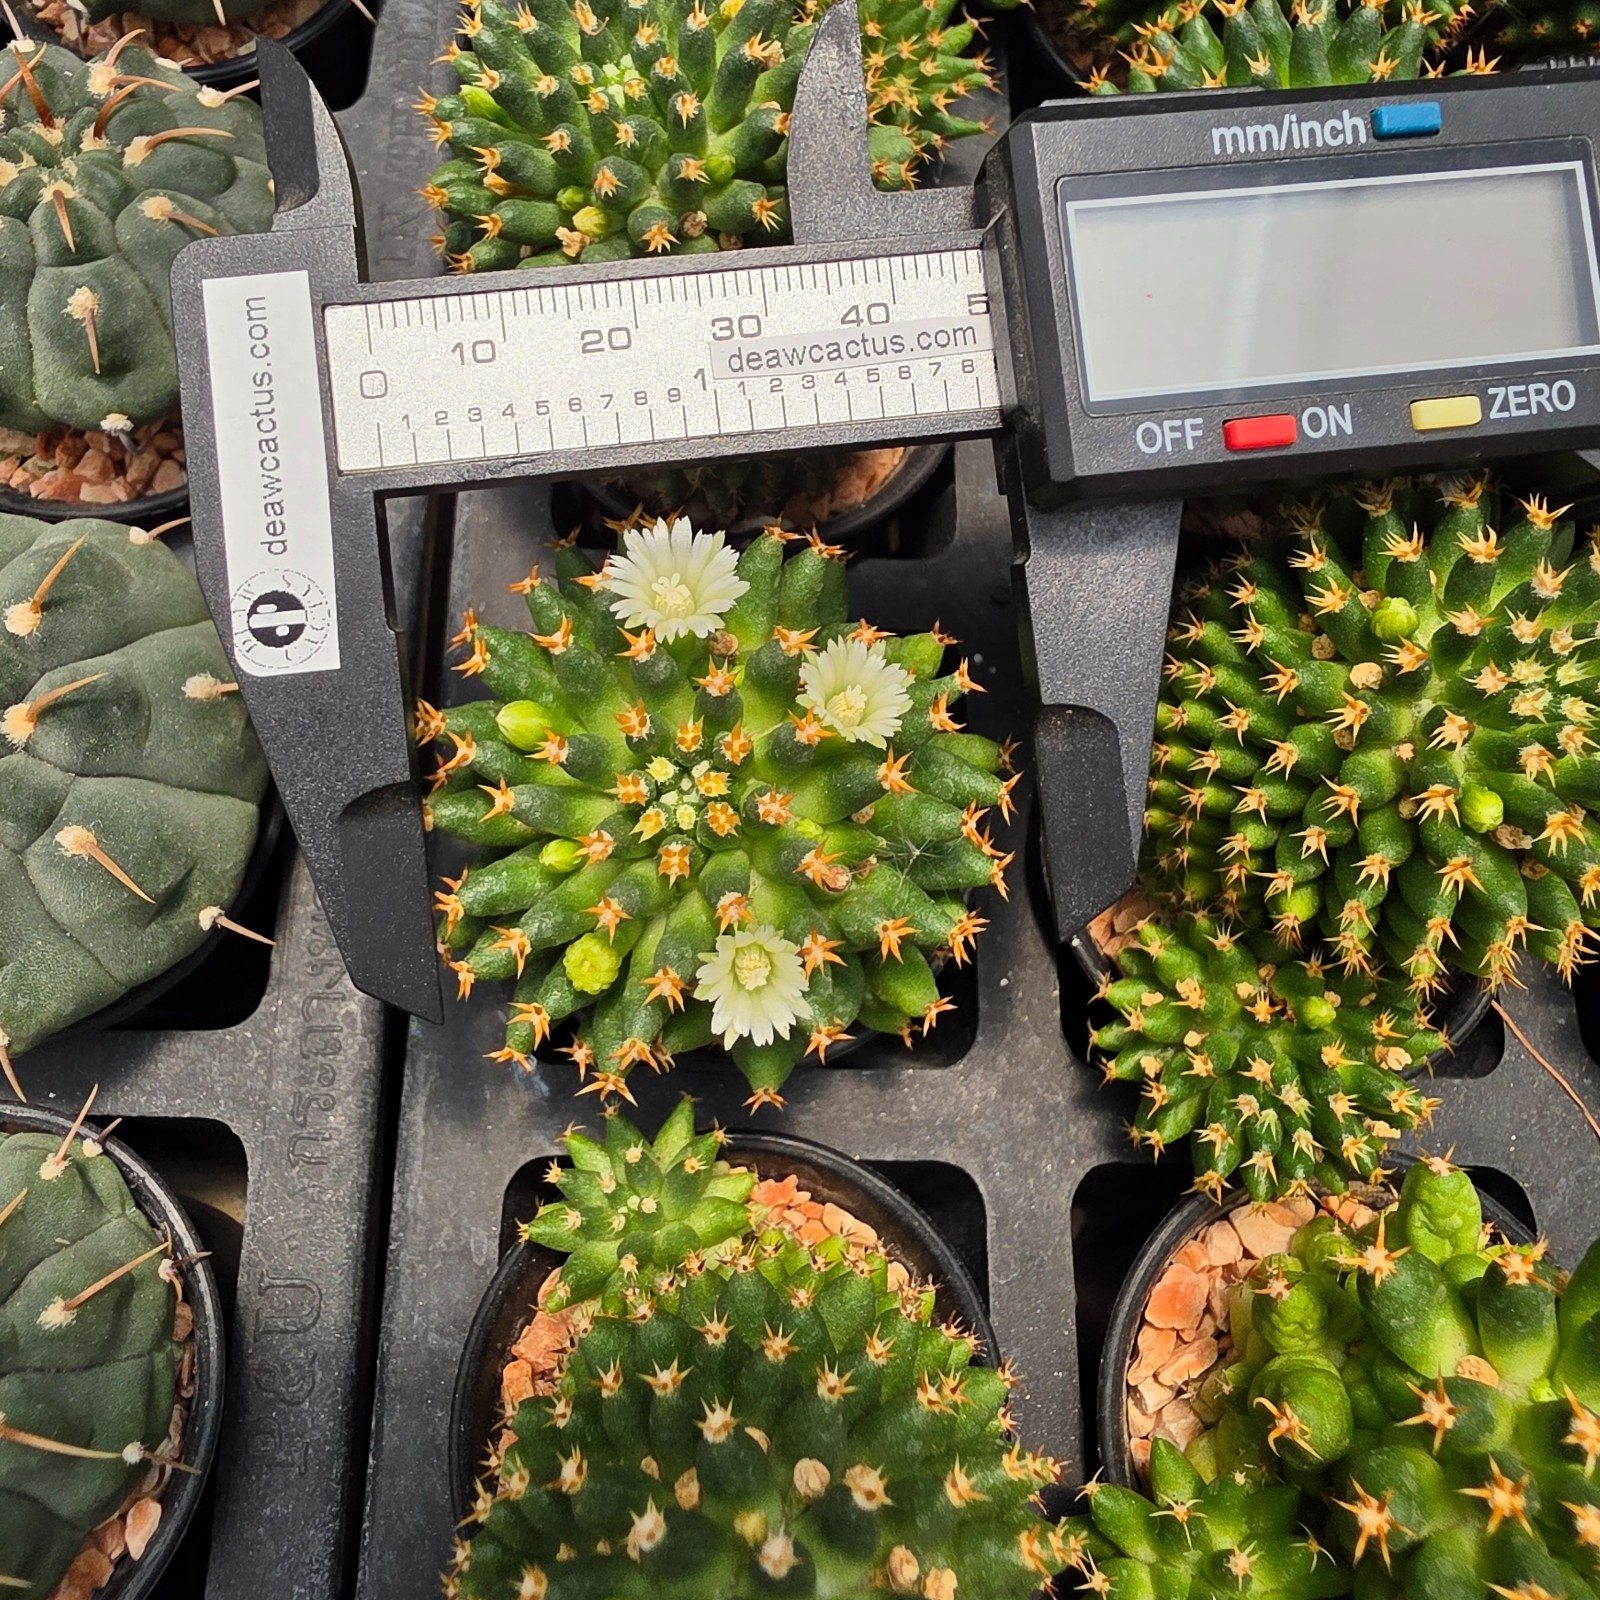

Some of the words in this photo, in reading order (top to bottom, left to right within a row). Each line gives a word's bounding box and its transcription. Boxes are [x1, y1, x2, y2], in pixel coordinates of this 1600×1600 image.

[1212, 110, 1366, 154] mm/inch
[360, 370, 388, 399] 0
[451, 340, 496, 365] 10
[581, 327, 631, 354] 20
[711, 315, 761, 341] 30
[841, 303, 890, 327] 40
[728, 325, 977, 372] deawcactus.com
[435, 411, 448, 425] 2
[468, 407, 482, 422] 3
[502, 404, 515, 418] 4
[535, 400, 549, 416] 5
[569, 397, 582, 412] 6
[600, 394, 613, 409] 7
[634, 391, 648, 405] 8
[667, 388, 681, 403] 9
[694, 368, 707, 391] 1
[769, 378, 784, 393] 2
[802, 375, 816, 389] 3
[834, 371, 847, 385] 4
[866, 368, 880, 383] 5
[898, 365, 911, 380] 6
[929, 362, 941, 376] 7
[961, 359, 975, 373] 8
[1488, 380, 1575, 419] ZERO
[246, 297, 287, 555] deawcactus.com
[1137, 418, 1202, 453] OFF
[1302, 404, 1352, 438] ON
